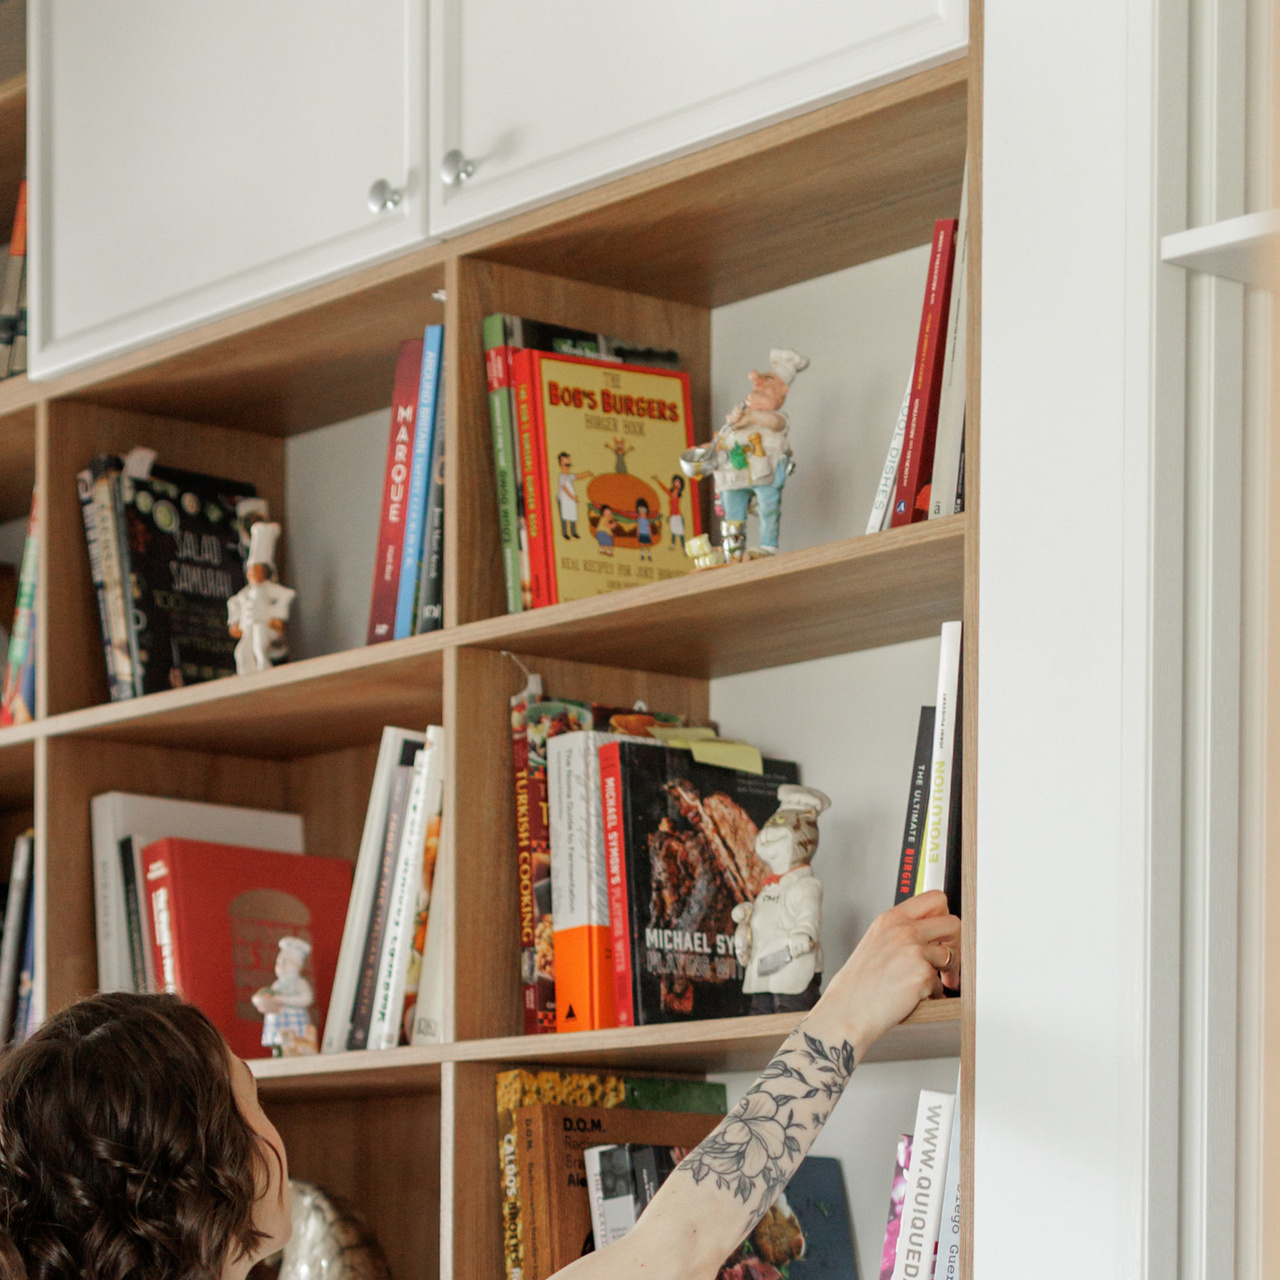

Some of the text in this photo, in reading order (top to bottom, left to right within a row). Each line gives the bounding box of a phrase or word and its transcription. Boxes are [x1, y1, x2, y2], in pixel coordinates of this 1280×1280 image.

[420, 350, 435, 403] AROUND
[548, 381, 679, 422] BOB'S BURGERS
[415, 406, 430, 453] BRITAIN
[874, 447, 899, 511] DISHES
[603, 776, 617, 829] MICHAEL
[899, 764, 925, 894] THE ULTIMATE BURGER
[929, 761, 946, 863] EVOLUTION
[516, 769, 533, 942] TURKISH COOKING
[607, 831, 621, 884] SYMON'S
[645, 928, 736, 955] MICHAEL SY
[646, 950, 743, 980] PLAYING WIT
[563, 1117, 606, 1133] D.O.M.
[503, 1132, 516, 1196] CALDOS
[506, 1201, 520, 1263] BROTHS
[951, 1184, 961, 1234] iego
